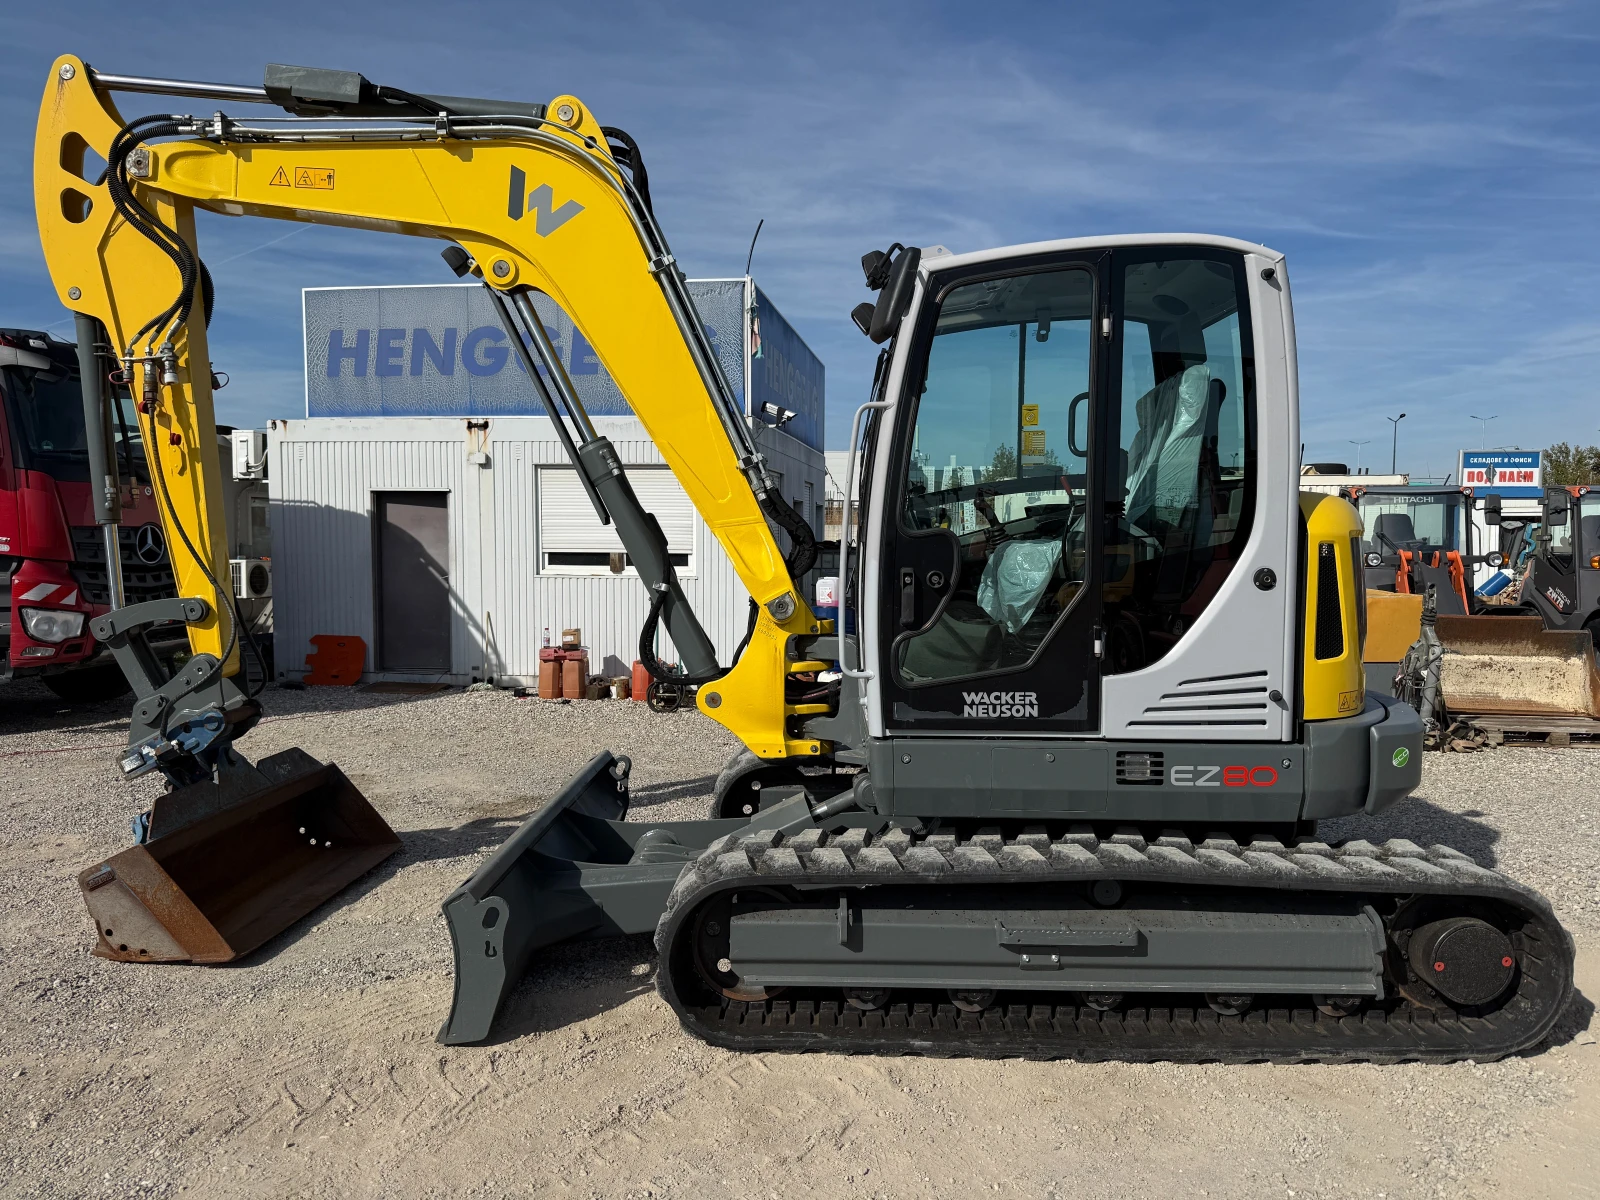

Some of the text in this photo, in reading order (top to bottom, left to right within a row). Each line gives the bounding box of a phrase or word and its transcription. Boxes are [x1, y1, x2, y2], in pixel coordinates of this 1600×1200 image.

[1498, 470, 1534, 483] НАЕМ
[1393, 496, 1434, 504] HITACHI
[1546, 586, 1565, 609] ZW75
[962, 691, 1039, 705] WACKER
[963, 704, 1039, 718] NEUSON
[1170, 765, 1279, 787] EZ80
